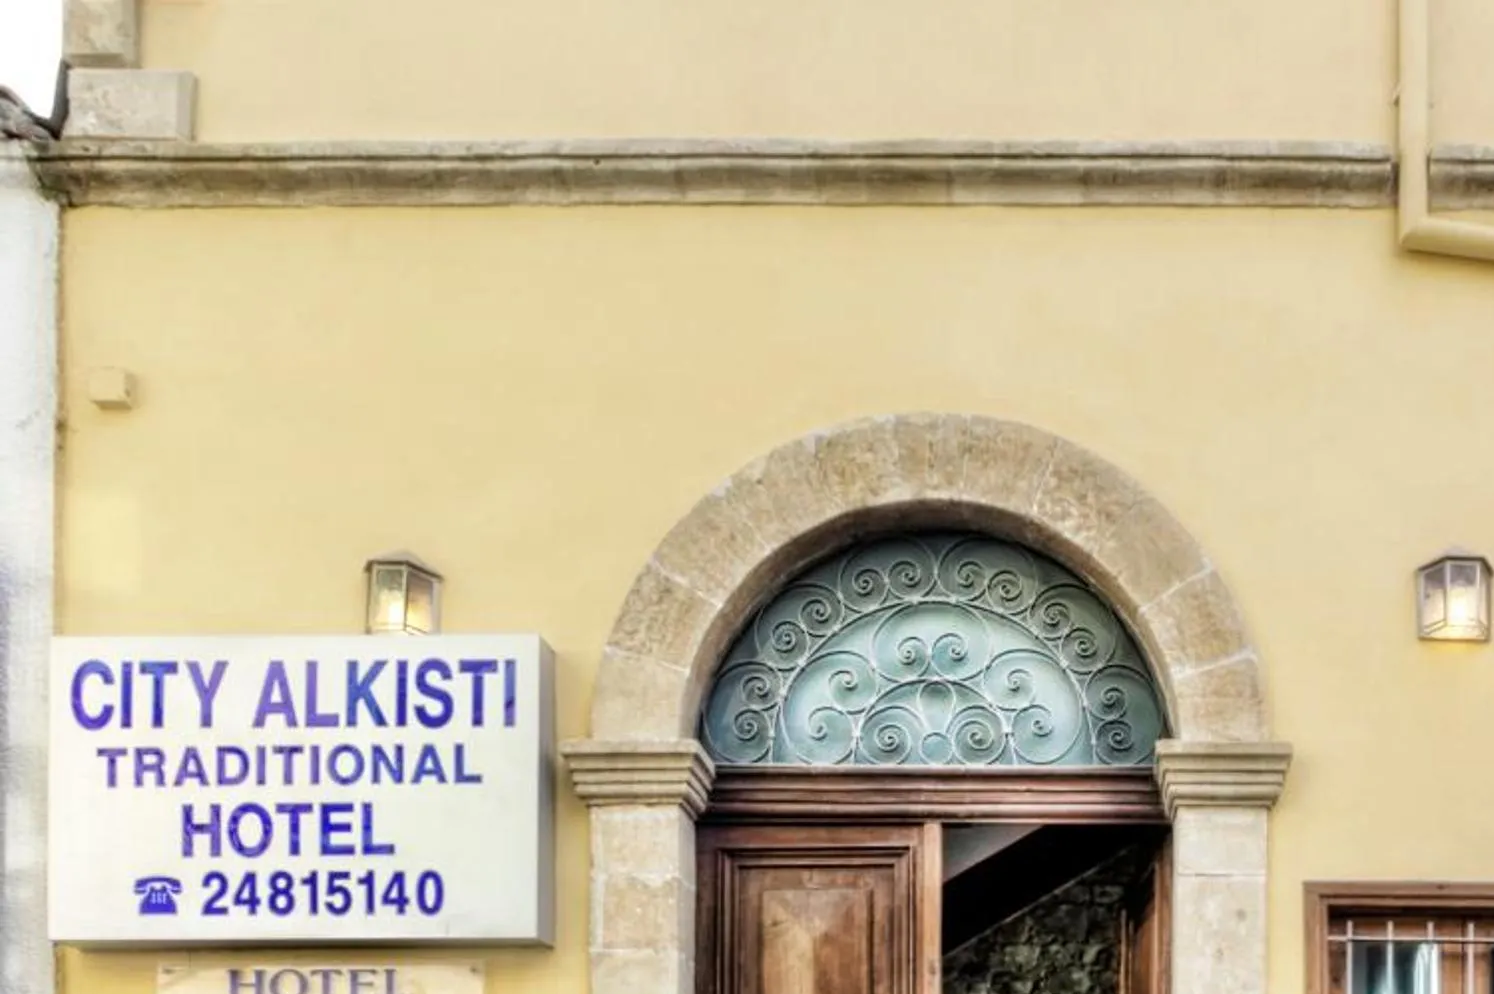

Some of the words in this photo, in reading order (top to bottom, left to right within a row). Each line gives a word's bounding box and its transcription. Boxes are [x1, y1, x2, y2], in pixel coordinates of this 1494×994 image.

[71, 659, 229, 730] CITY
[252, 659, 517, 728] ALKISTI
[97, 744, 483, 788] TRADITIONAL
[181, 802, 396, 858] HOTEL
[201, 870, 444, 916] 24815140
